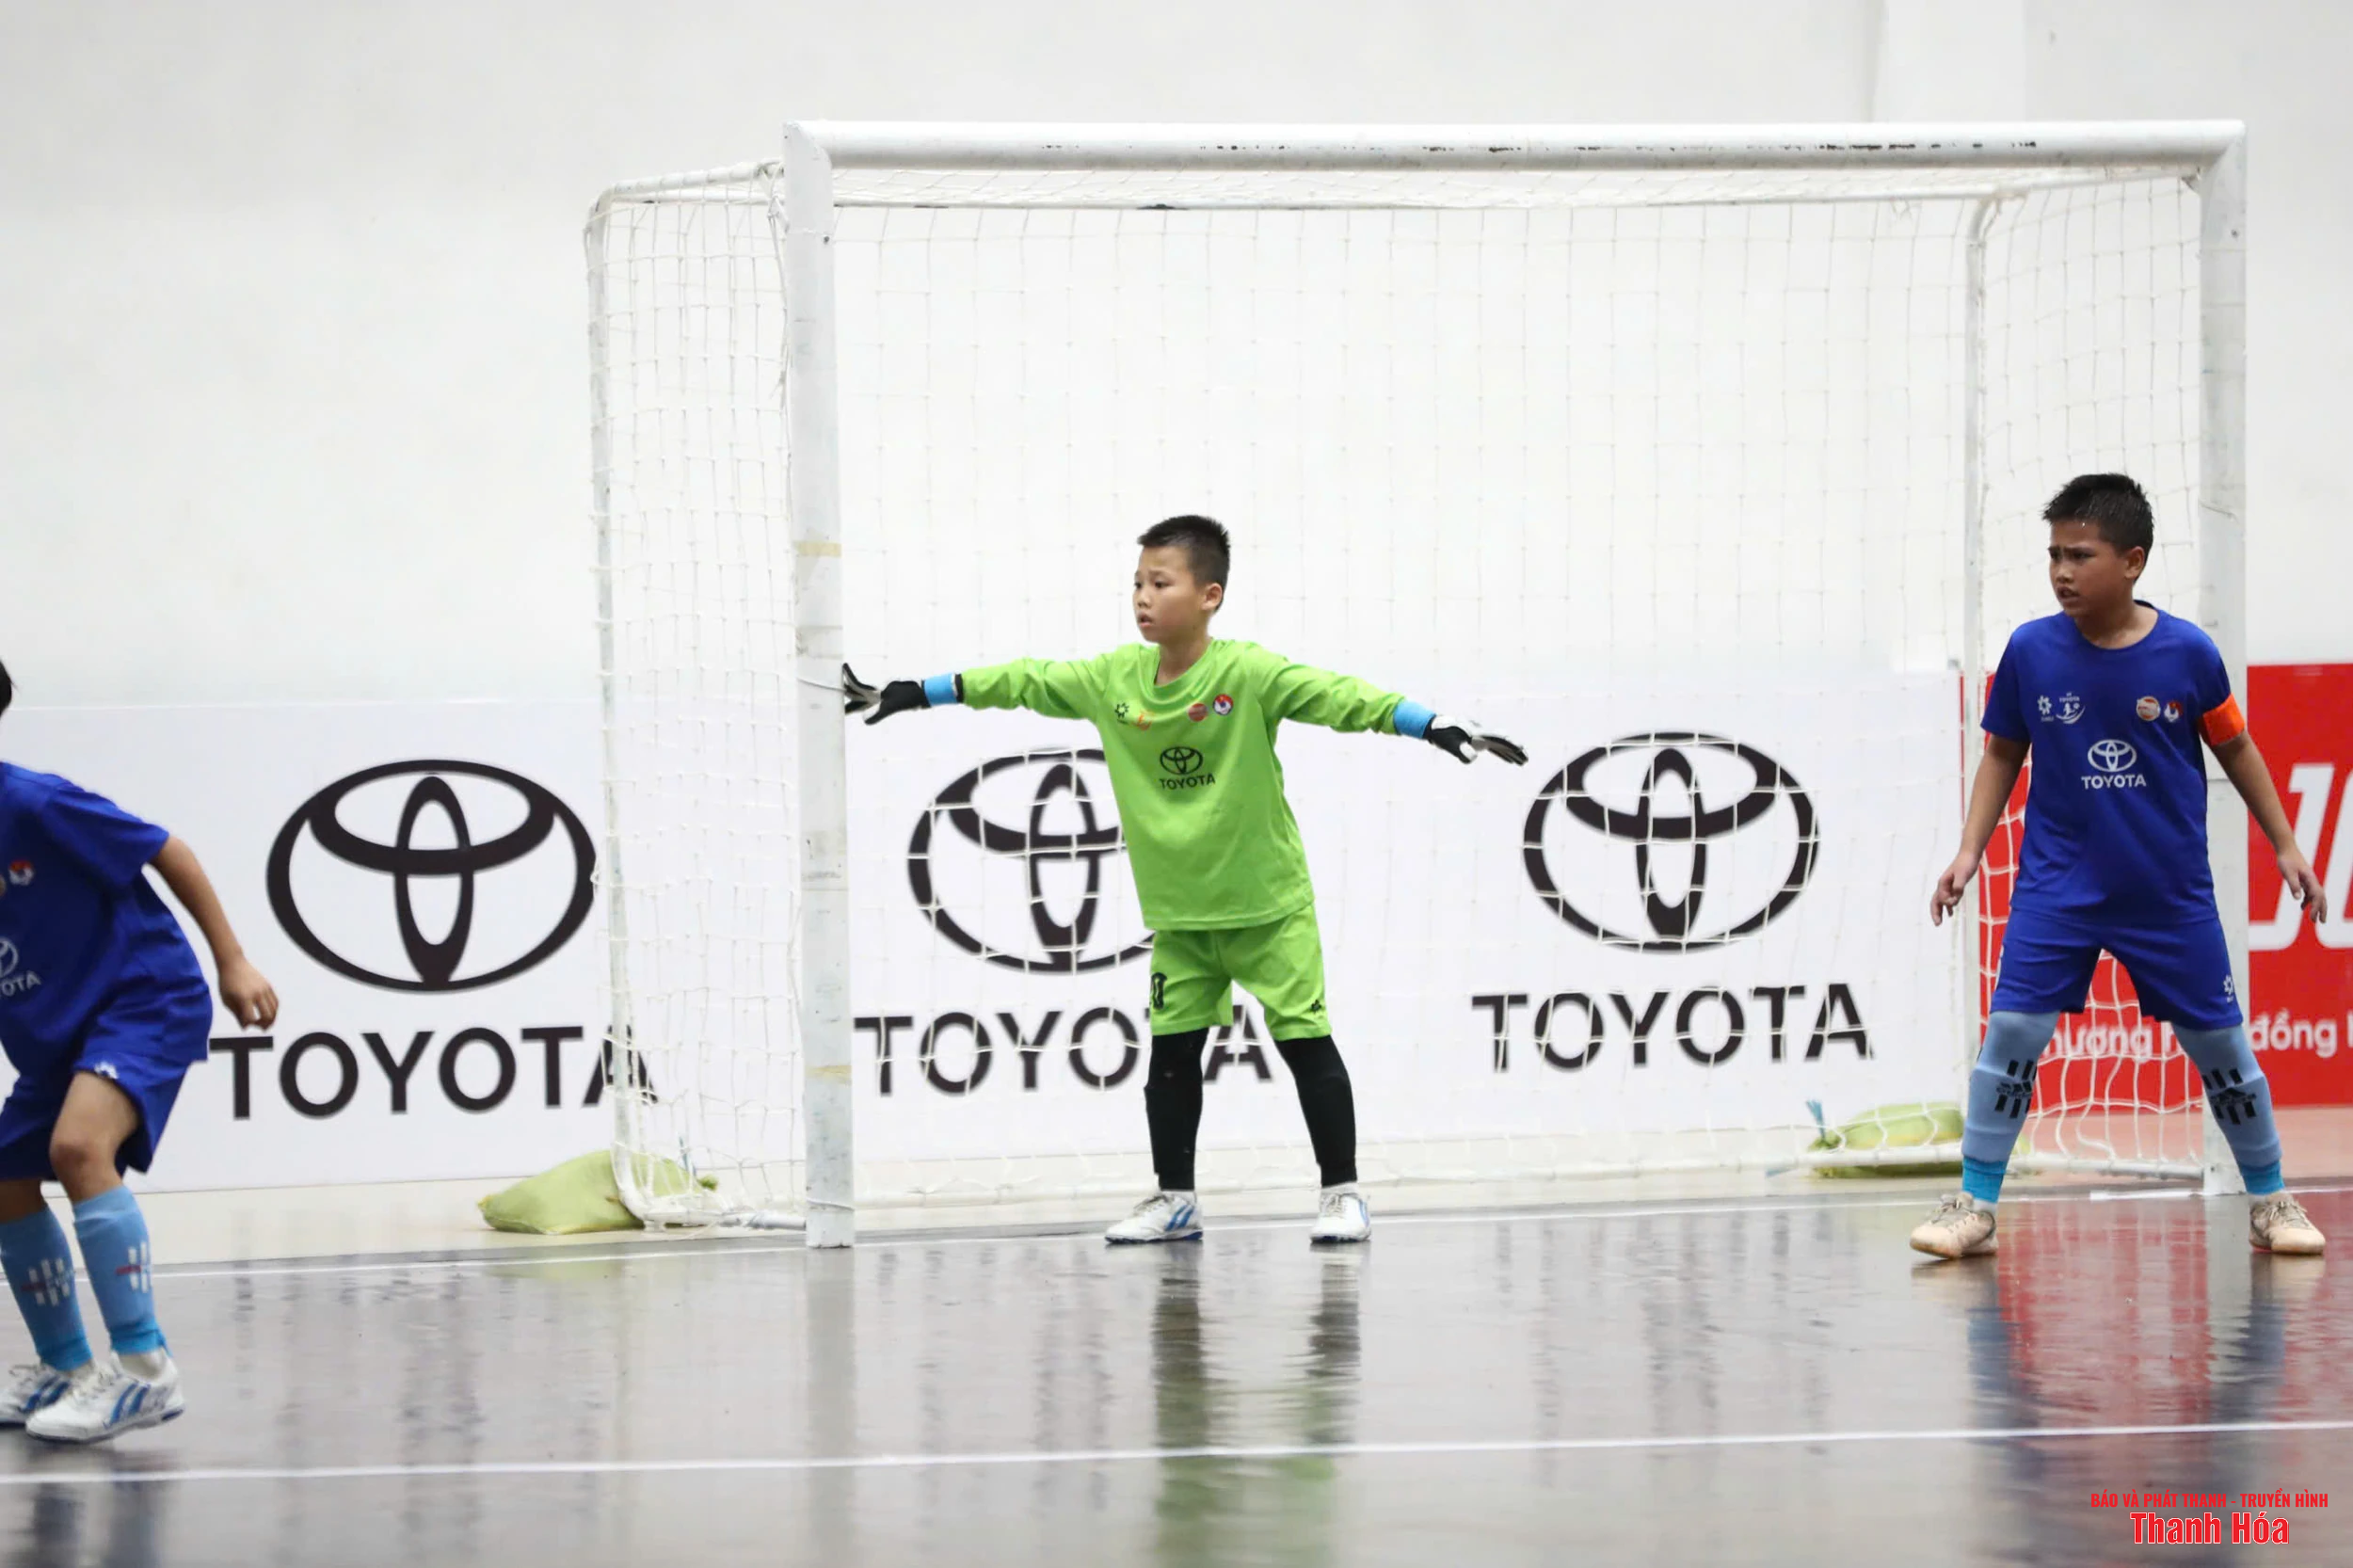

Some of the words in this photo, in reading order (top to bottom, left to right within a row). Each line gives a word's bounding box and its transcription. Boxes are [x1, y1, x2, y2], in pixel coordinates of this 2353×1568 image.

[1159, 773, 1216, 791] TOYOTA
[2081, 774, 2147, 790] TOYOTA
[0, 969, 42, 998] OTA
[853, 1004, 1273, 1096] TOYOA
[1471, 984, 1873, 1073] TOYOTA
[209, 1025, 658, 1119] TOYOTA
